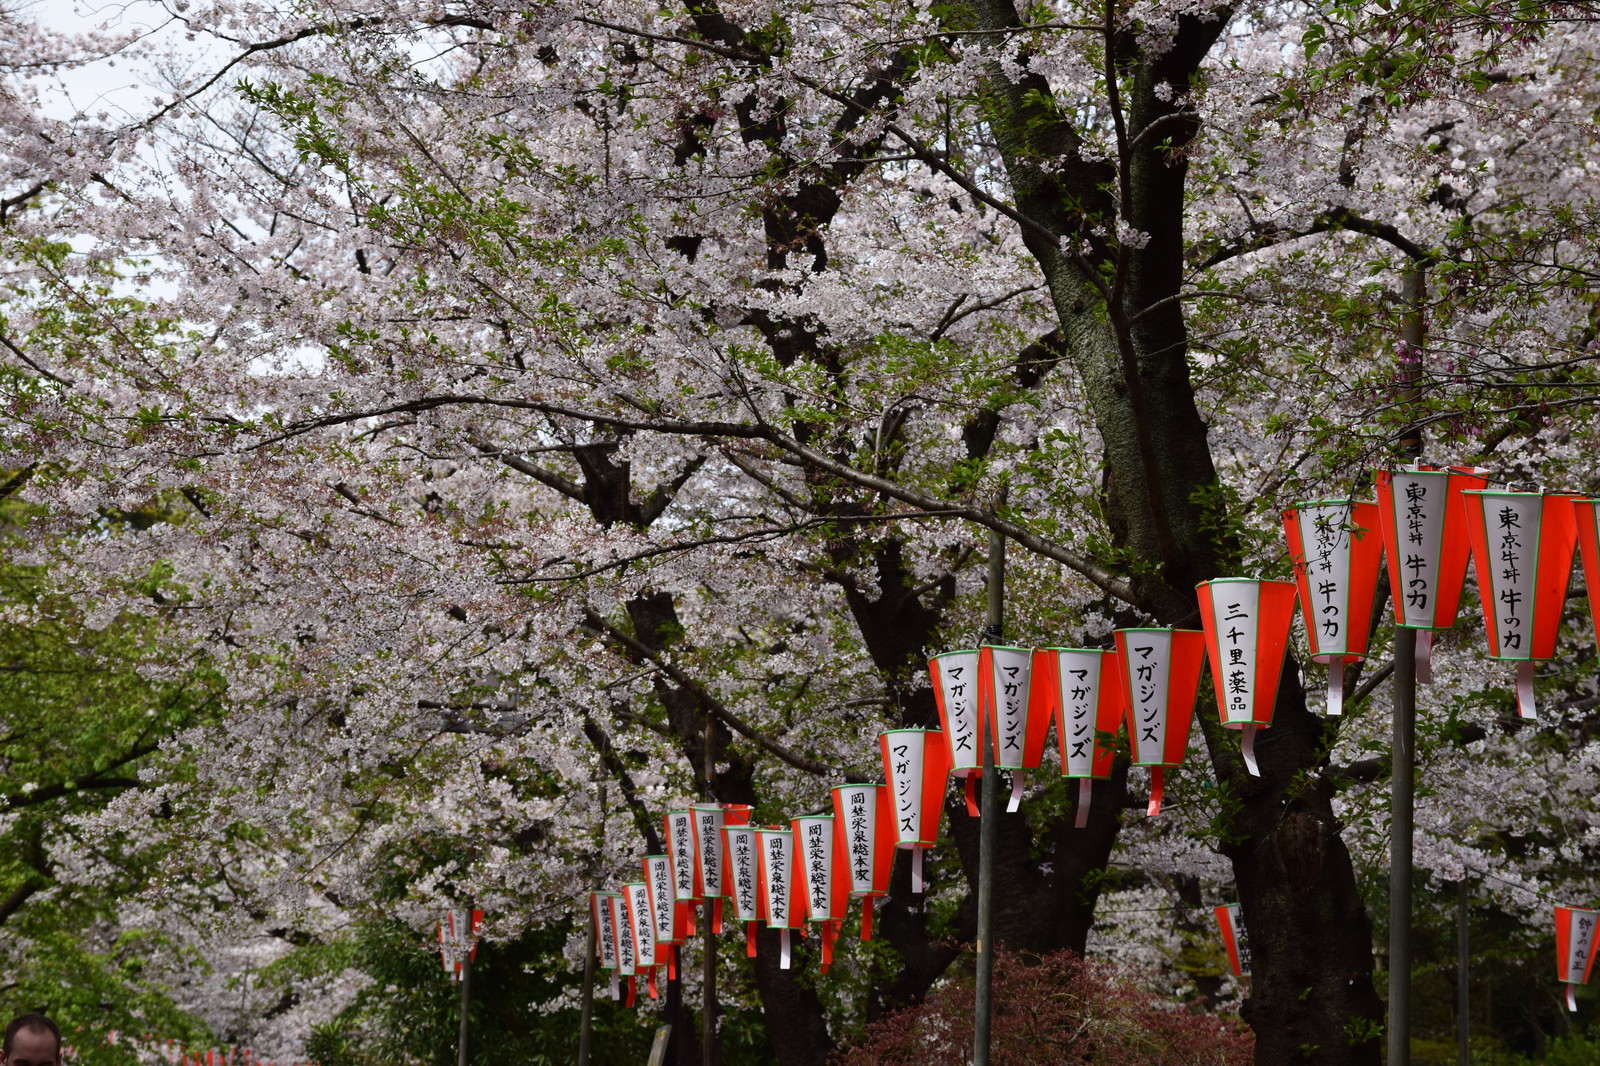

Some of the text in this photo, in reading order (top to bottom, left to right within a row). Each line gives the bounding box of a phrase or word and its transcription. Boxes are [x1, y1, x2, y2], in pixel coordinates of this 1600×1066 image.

[1134, 646, 1158, 743] マガジンズ
[1223, 602, 1249, 711] 三千里薬品
[948, 666, 973, 751] マガジンズ
[1003, 666, 1024, 751] マガジンズ
[1069, 669, 1092, 759] マガジンズ
[893, 744, 917, 833] マガジンズ
